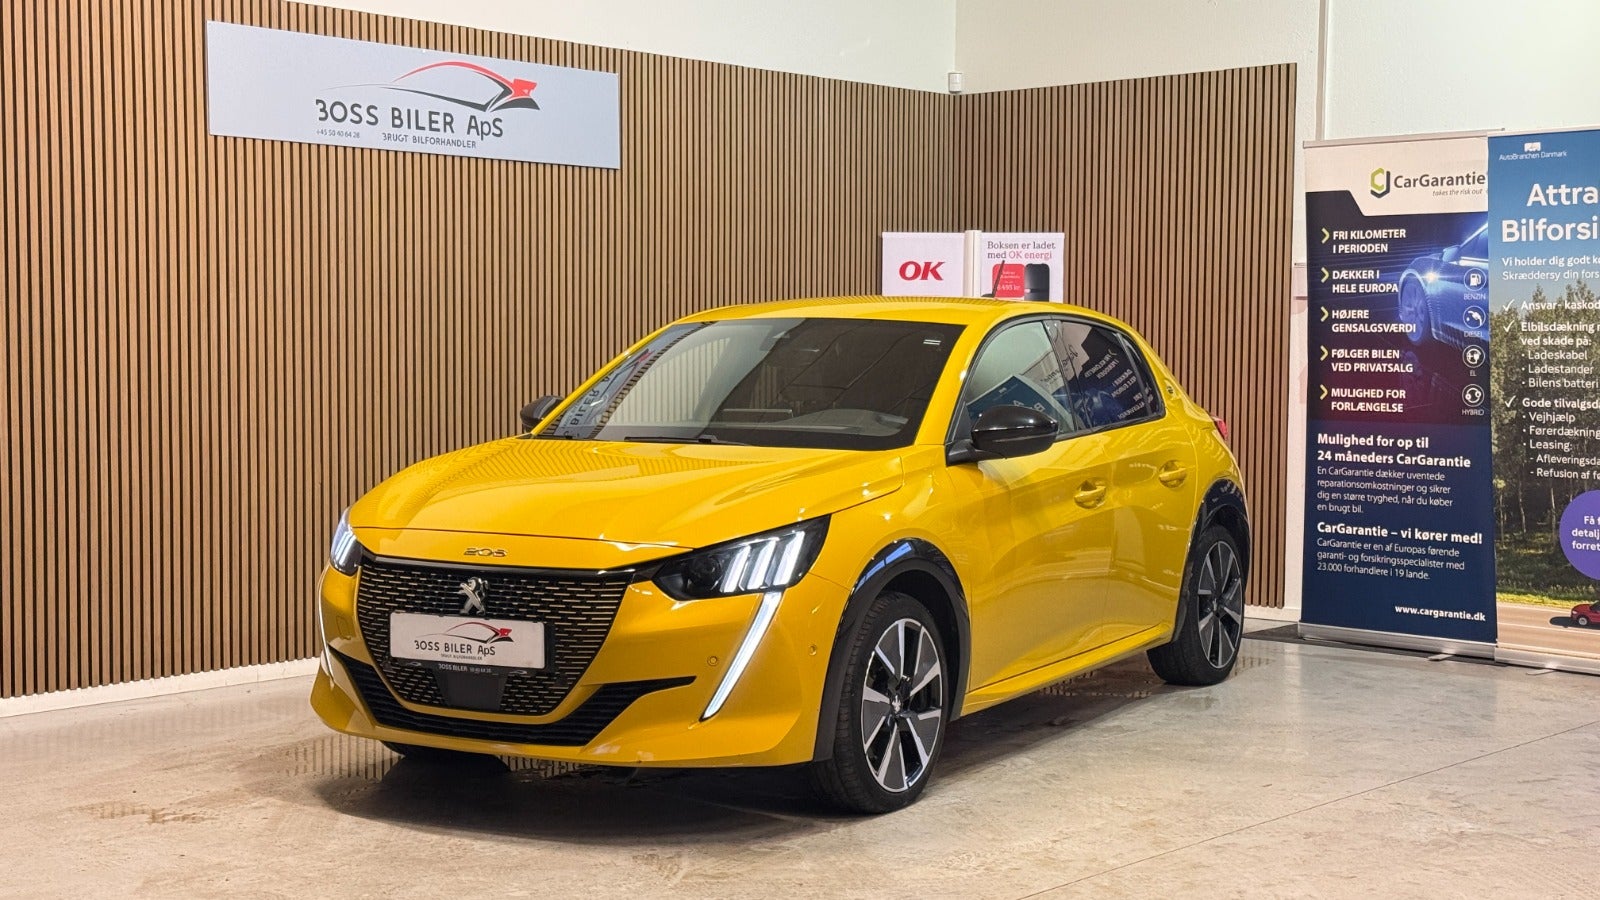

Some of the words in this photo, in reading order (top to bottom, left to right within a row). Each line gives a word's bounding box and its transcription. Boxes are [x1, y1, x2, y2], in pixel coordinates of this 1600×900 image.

[391, 107, 454, 133] BILER
[467, 115, 503, 140] ApS
[412, 135, 476, 148] BILFORHANDLER
[1499, 152, 1540, 160] AutoBranchen
[1394, 171, 1486, 189] CarGarantie
[1526, 184, 1598, 206] Attra
[1333, 229, 1348, 240] FRI
[1350, 228, 1406, 239] KILOMETER
[1502, 216, 1598, 242] Bilforsi
[987, 241, 1018, 249] Boksen
[1033, 241, 1056, 249] ladet
[1333, 245, 1336, 253] I
[1338, 244, 1388, 253] PERIODEN
[987, 251, 1007, 259] med
[1009, 251, 1023, 259] OK
[1025, 252, 1052, 260] energi
[1502, 257, 1513, 266] Vi
[1515, 257, 1546, 266] holder
[1549, 256, 1564, 267] dig
[1567, 255, 1590, 266] godt
[899, 261, 945, 280] OK
[1333, 270, 1374, 280] DÆKKER
[1376, 270, 1379, 278] I
[1502, 271, 1560, 281] Skræddersy
[1563, 270, 1578, 279] din
[1582, 269, 1599, 279] fors
[1332, 283, 1355, 293] HELE
[1358, 283, 1398, 292] EUROPA
[1522, 301, 1562, 310] Ansvar-
[1332, 309, 1369, 320] HØJERE
[1332, 323, 1416, 333] GENSALGSVÆRDI
[1522, 322, 1594, 333] Elbilsdækning
[1543, 338, 1574, 346] skade
[1576, 337, 1592, 347] på:
[1332, 349, 1368, 360] FØLGER
[1371, 350, 1399, 359] BILEN
[1528, 351, 1588, 359] Ladeskabel
[1332, 363, 1351, 372] VED
[1354, 363, 1413, 373] PRIVATSALG
[1528, 365, 1594, 374] Ladestander
[1529, 378, 1561, 387] Bilens
[1564, 379, 1598, 388] batteri
[1331, 388, 1383, 399] MULIGHED
[1386, 389, 1406, 398] FOR
[1331, 402, 1403, 413] FORLÆNGELSE
[1522, 398, 1551, 407] Gode
[1529, 412, 1575, 424] Vejhjælp
[1530, 426, 1600, 438] Førerdækning
[1318, 433, 1374, 447] Mulighed
[1377, 435, 1394, 447] for
[1397, 439, 1413, 450] op
[1416, 437, 1429, 448] til
[1530, 440, 1572, 451] Leasing:
[1318, 451, 1331, 461] 24
[1335, 450, 1393, 464] måneders
[1397, 454, 1471, 468] CarGarantie
[1318, 466, 1326, 475] En
[1329, 467, 1374, 477] CarGarantie
[1376, 469, 1404, 479] dækker
[1407, 472, 1445, 481] uventede
[1537, 469, 1578, 478] Refusion
[1581, 471, 1590, 479] af
[1318, 479, 1414, 493] reparationsomkostninger
[1416, 486, 1427, 494] og
[1429, 485, 1450, 493] sikrer
[1317, 492, 1329, 500] dig
[1367, 495, 1399, 504] tryghed,
[1402, 496, 1414, 504] når
[1416, 497, 1427, 505] du
[1430, 498, 1452, 506] køber
[1329, 504, 1350, 514] brugt
[1352, 505, 1363, 513] bil.
[1584, 516, 1595, 524] Få
[1317, 522, 1388, 537] CarGarantie
[1400, 528, 1411, 538] vi
[1415, 529, 1447, 542] kører
[1451, 533, 1482, 544] med!
[1572, 528, 1599, 540] detalj
[1317, 538, 1362, 549] CarGarantie
[1373, 543, 1383, 551] en
[1385, 543, 1393, 551] af
[1395, 544, 1425, 554] Europas
[1428, 547, 1459, 557] førende
[1317, 552, 1346, 560] garanti-
[1348, 554, 1358, 562] og
[1361, 554, 1444, 568] forsikringsspecialister
[1446, 560, 1464, 570] med
[1317, 562, 1342, 571] 23.000
[1344, 564, 1388, 576] forhandlere
[1390, 568, 1392, 576] i
[1395, 569, 1404, 577] 19
[1406, 570, 1430, 580] lande.
[1395, 605, 1485, 621] www.cargarantie.dk
[444, 643, 472, 653] BILER
[478, 645, 495, 657] ApS
